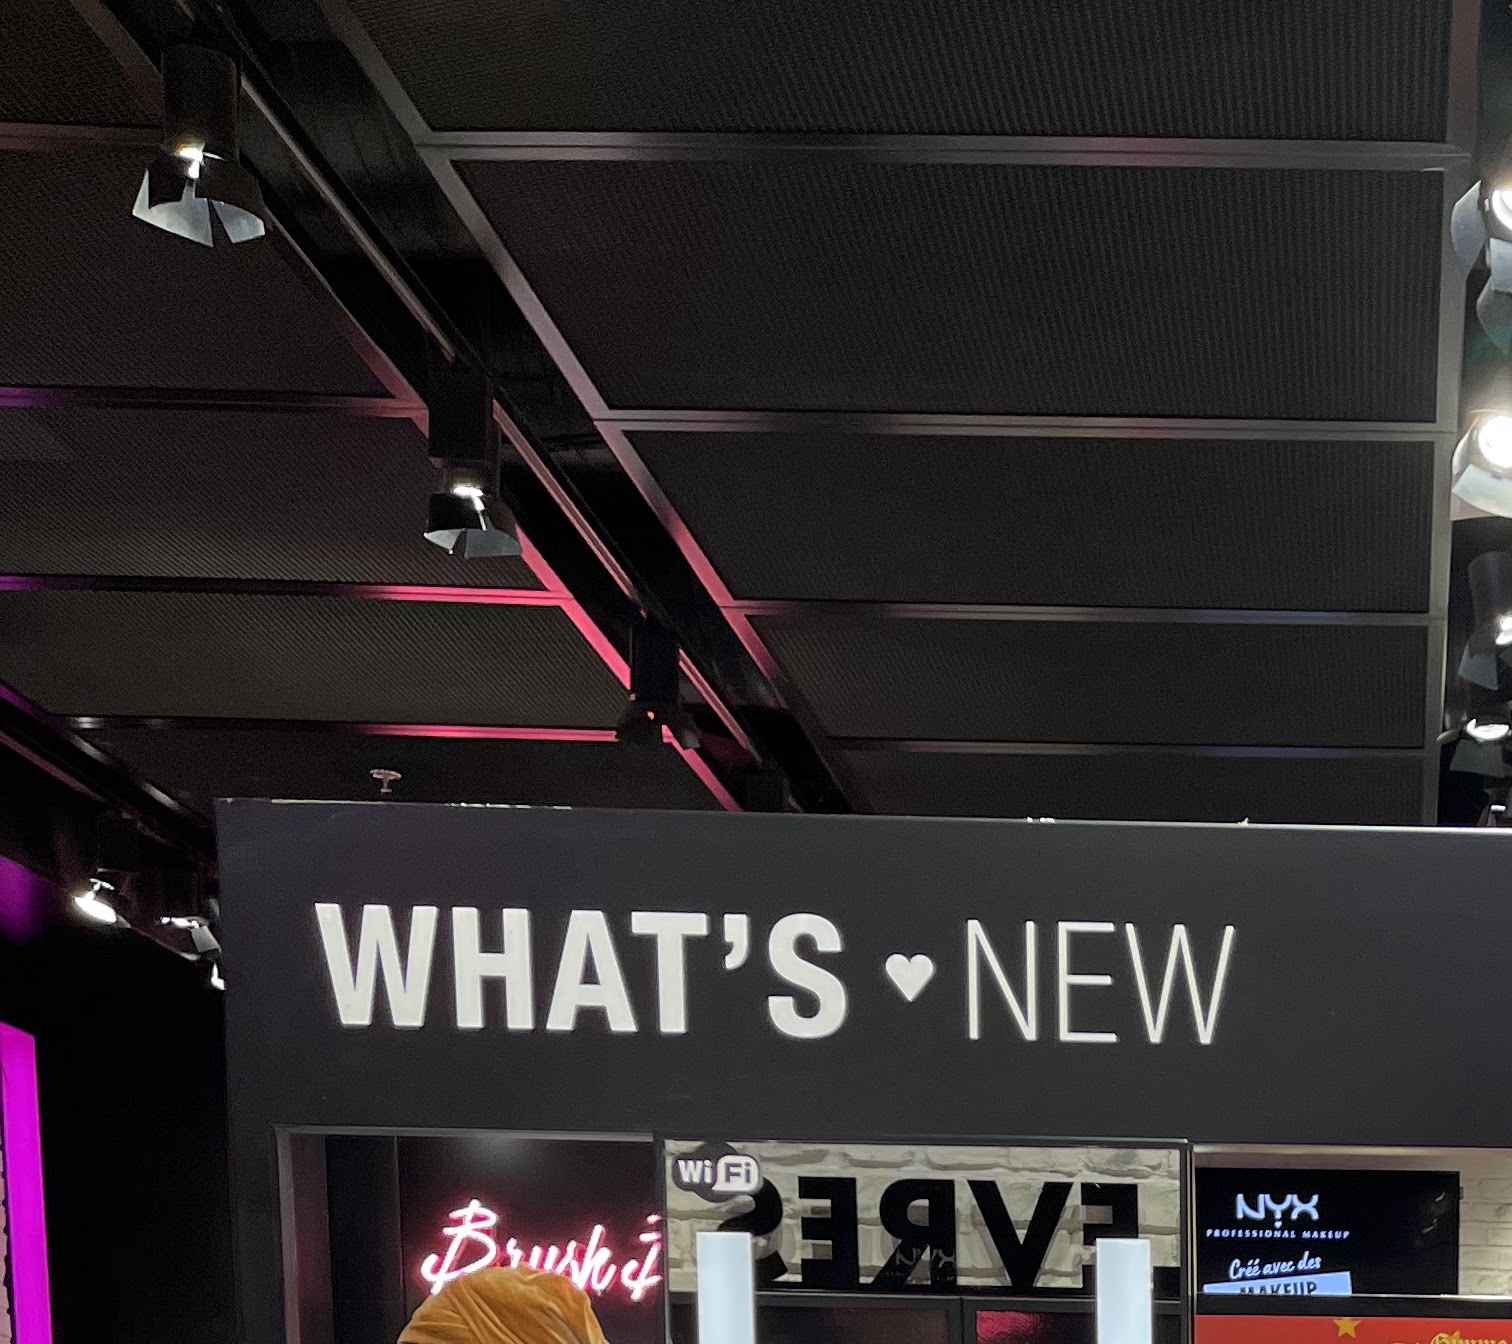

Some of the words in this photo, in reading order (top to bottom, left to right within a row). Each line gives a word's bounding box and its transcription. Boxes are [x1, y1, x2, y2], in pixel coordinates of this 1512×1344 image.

[314, 902, 846, 1039] WHAT'S
[967, 918, 1235, 1045] NEW
[677, 1158, 756, 1186] WiFi
[1235, 1193, 1319, 1221] NYX
[420, 1198, 616, 1296] Brush
[1206, 1229, 1296, 1239] PROFESSIONAL
[1301, 1230, 1350, 1239] MAKEUP
[1229, 1258, 1261, 1280] Créé
[1262, 1260, 1295, 1275] avec
[1297, 1250, 1322, 1269] des
